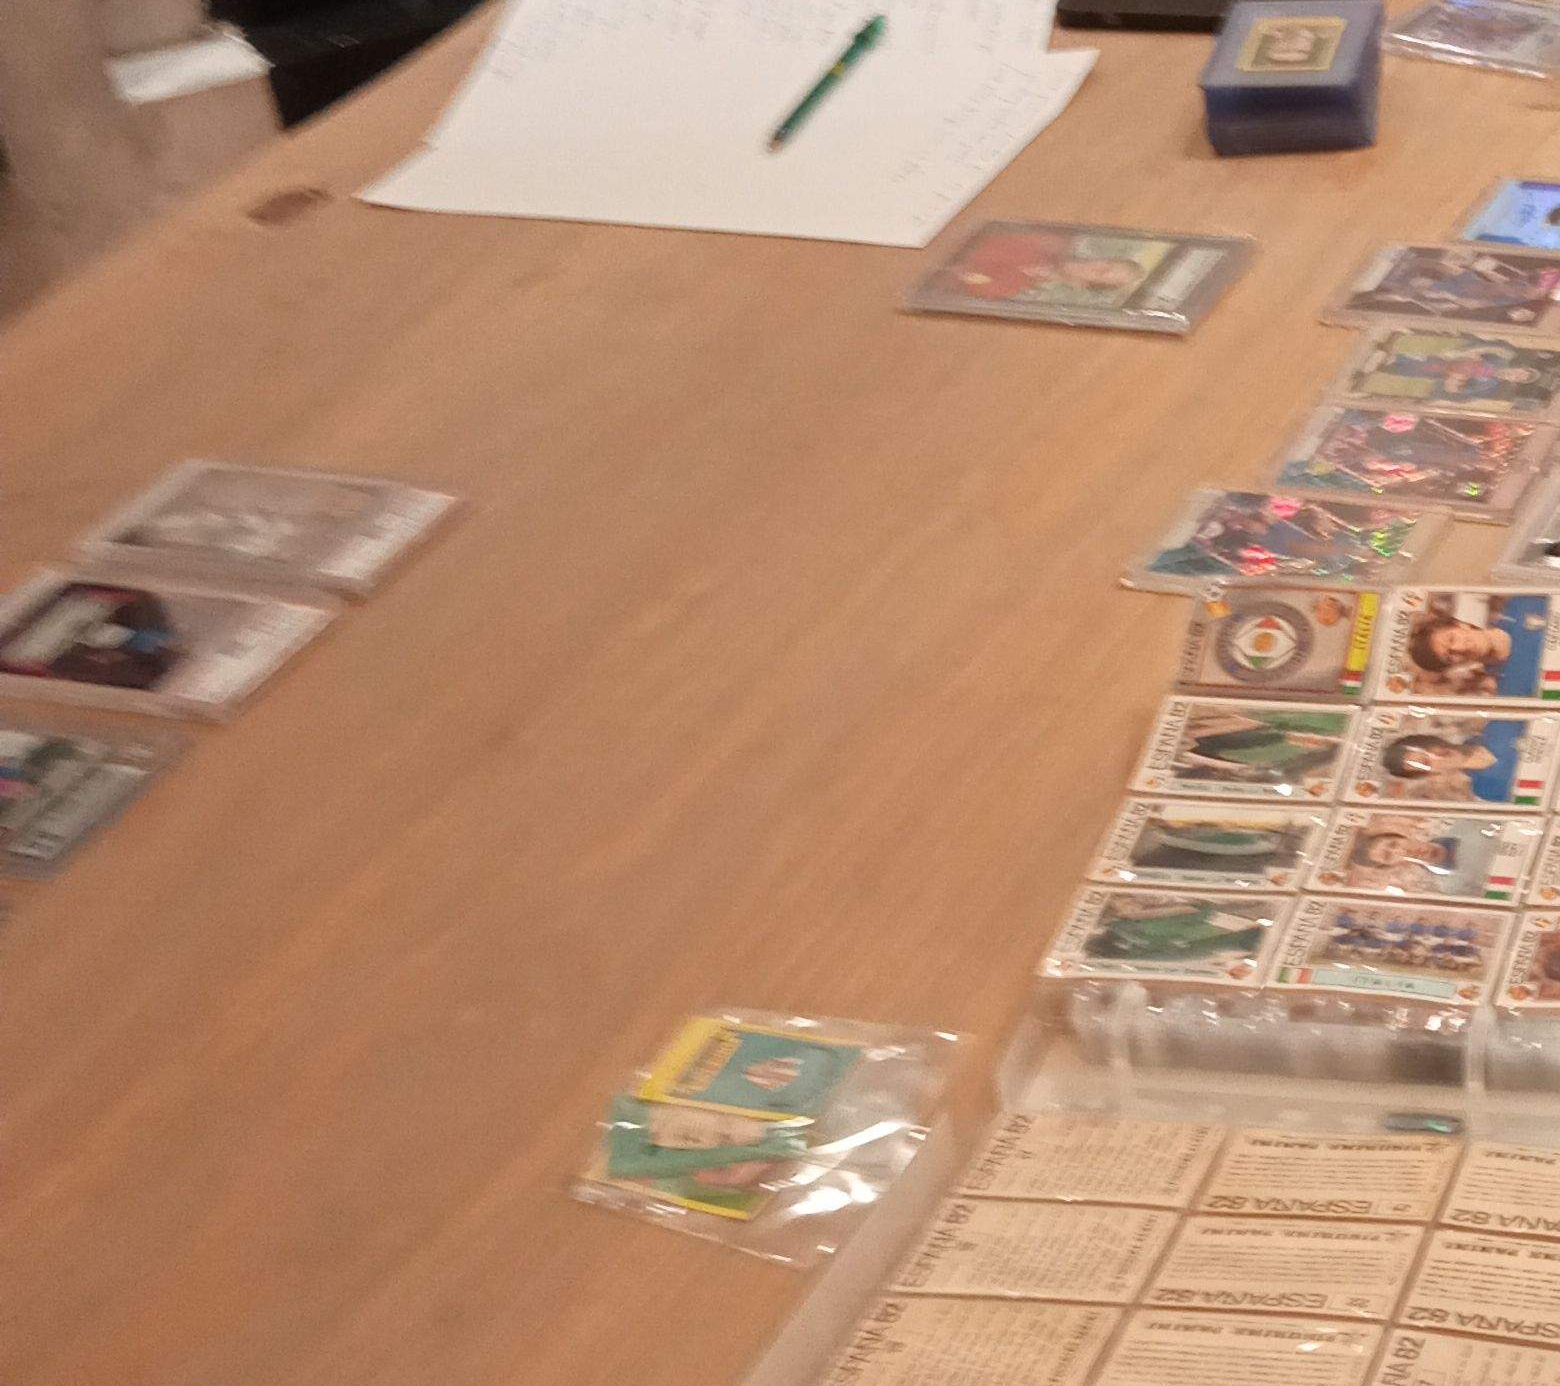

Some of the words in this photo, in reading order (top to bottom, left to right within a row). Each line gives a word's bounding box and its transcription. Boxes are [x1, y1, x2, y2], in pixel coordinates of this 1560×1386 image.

[1256, 1197, 1371, 1213] ESPAÑA
[1451, 1209, 1490, 1224] 82
[1203, 1289, 1326, 1308] ESPAÑA
[1407, 1305, 1448, 1323] 82
[1393, 1337, 1425, 1359] 82
